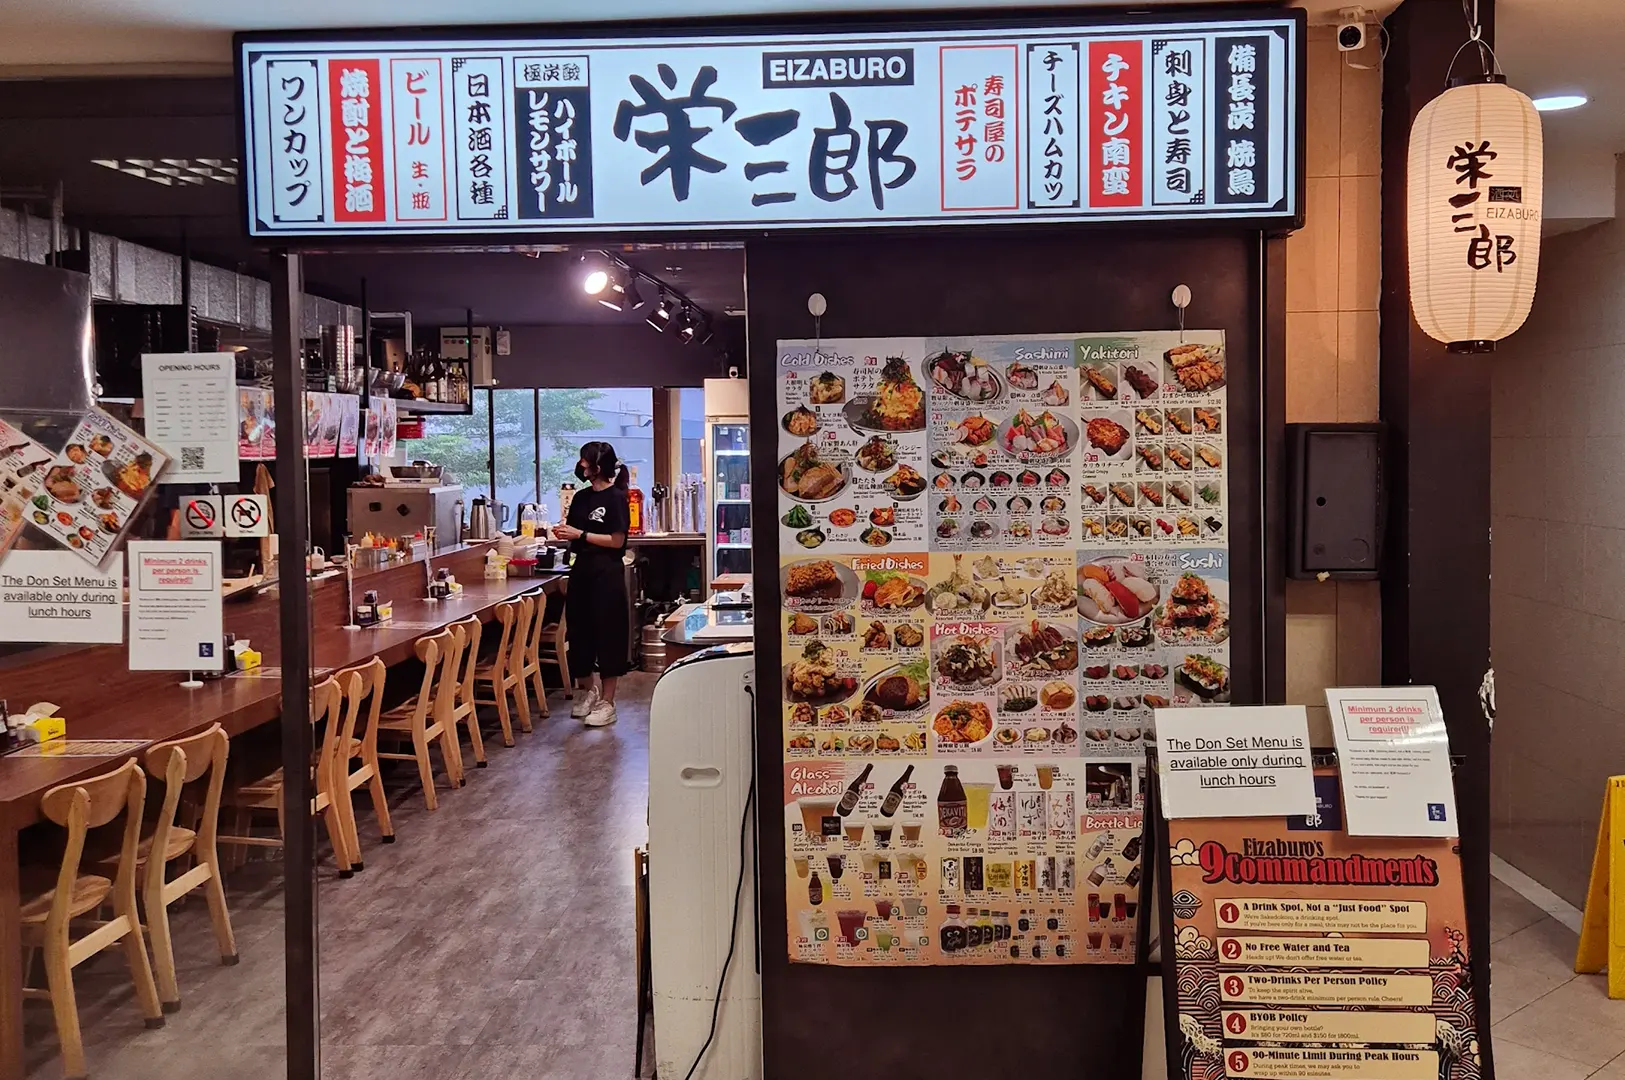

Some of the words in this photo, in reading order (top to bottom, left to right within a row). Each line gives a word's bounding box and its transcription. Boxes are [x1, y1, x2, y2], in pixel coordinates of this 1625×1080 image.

[523, 62, 581, 83] 極炭酸
[769, 56, 907, 83] EIZABURO
[1227, 44, 1256, 132] 備長炭
[406, 69, 431, 147] ビール
[984, 75, 1005, 163] 寿司屋の
[1042, 50, 1064, 201] チーズハムカツ
[1101, 53, 1130, 196] チキン南蛮
[1164, 50, 1192, 194] 刺身と寿司
[467, 73, 496, 206] 日本酒各種
[613, 63, 917, 211] 栄三郎
[954, 83, 979, 181] ポテサラ
[281, 76, 312, 207] ワンカップ
[339, 68, 374, 213] 焼酎と梅酒
[528, 90, 552, 213] レモンサワー
[553, 98, 578, 203] ハイボール
[1227, 139, 1256, 197] 焼鳥
[1446, 140, 1517, 273] 栄三郎
[1486, 207, 1539, 221] EIZABURO
[781, 353, 811, 367] Cold
[815, 352, 855, 367] Dishes
[1014, 347, 1069, 361] Sashimi
[1080, 345, 1140, 360] Yakitori
[144, 558, 177, 566] Minimum
[184, 558, 207, 566] drinks
[851, 558, 885, 571] Fried
[885, 557, 924, 570] Dishes
[1179, 552, 1224, 570] Sushi
[2, 575, 23, 585] The
[27, 575, 49, 586] Don
[52, 575, 71, 586] Set
[74, 576, 104, 587] Menu
[108, 577, 117, 587] is
[4, 591, 52, 601] available
[55, 592, 78, 603] only
[81, 592, 116, 604] during
[28, 607, 58, 616] lunch
[61, 607, 92, 617] hours
[935, 622, 957, 636] Hot
[959, 622, 998, 636] Dishes
[1394, 705, 1422, 713] drinks
[1360, 716, 1374, 724] per
[1167, 738, 1191, 750] The
[1195, 738, 1222, 750] Don
[1226, 737, 1248, 749] Set
[1252, 736, 1288, 748] Menu
[1292, 736, 1303, 747] is
[1170, 756, 1227, 769] available
[1231, 755, 1258, 769] only
[1262, 754, 1303, 768] during
[790, 767, 831, 781] Glass
[1200, 775, 1235, 786] lunch
[1239, 774, 1276, 785] hours
[791, 781, 843, 796] Alcohol
[1086, 816, 1122, 829] Bottle
[1243, 838, 1324, 857] Eizaburo's
[1225, 906, 1233, 921] 1
[1243, 903, 1249, 911] A
[1252, 903, 1278, 911] Drink
[1306, 904, 1321, 912] Not
[1390, 905, 1410, 914] Spot
[1300, 914, 1325, 922] drinking
[1227, 943, 1237, 958] 2
[1246, 943, 1257, 951] No
[1260, 943, 1280, 951] Free
[1283, 943, 1309, 951] Water
[1313, 944, 1331, 952] and
[1333, 944, 1350, 952] Tea
[1229, 979, 1239, 995] 3
[1248, 976, 1302, 984] Two-Drinks
[1304, 976, 1320, 984] Per
[1323, 976, 1356, 985] Person
[1359, 977, 1388, 986] Policy
[1231, 1017, 1241, 1033] 4
[1250, 1013, 1276, 1021] BYOB
[1279, 1013, 1308, 1023] Policy
[1235, 1055, 1244, 1071] 5
[1252, 1051, 1300, 1060] 90-Minute
[1302, 1051, 1326, 1060] Limit
[1329, 1052, 1362, 1061] During
[1364, 1052, 1389, 1060] Peak
[1391, 1052, 1420, 1061] Hours
